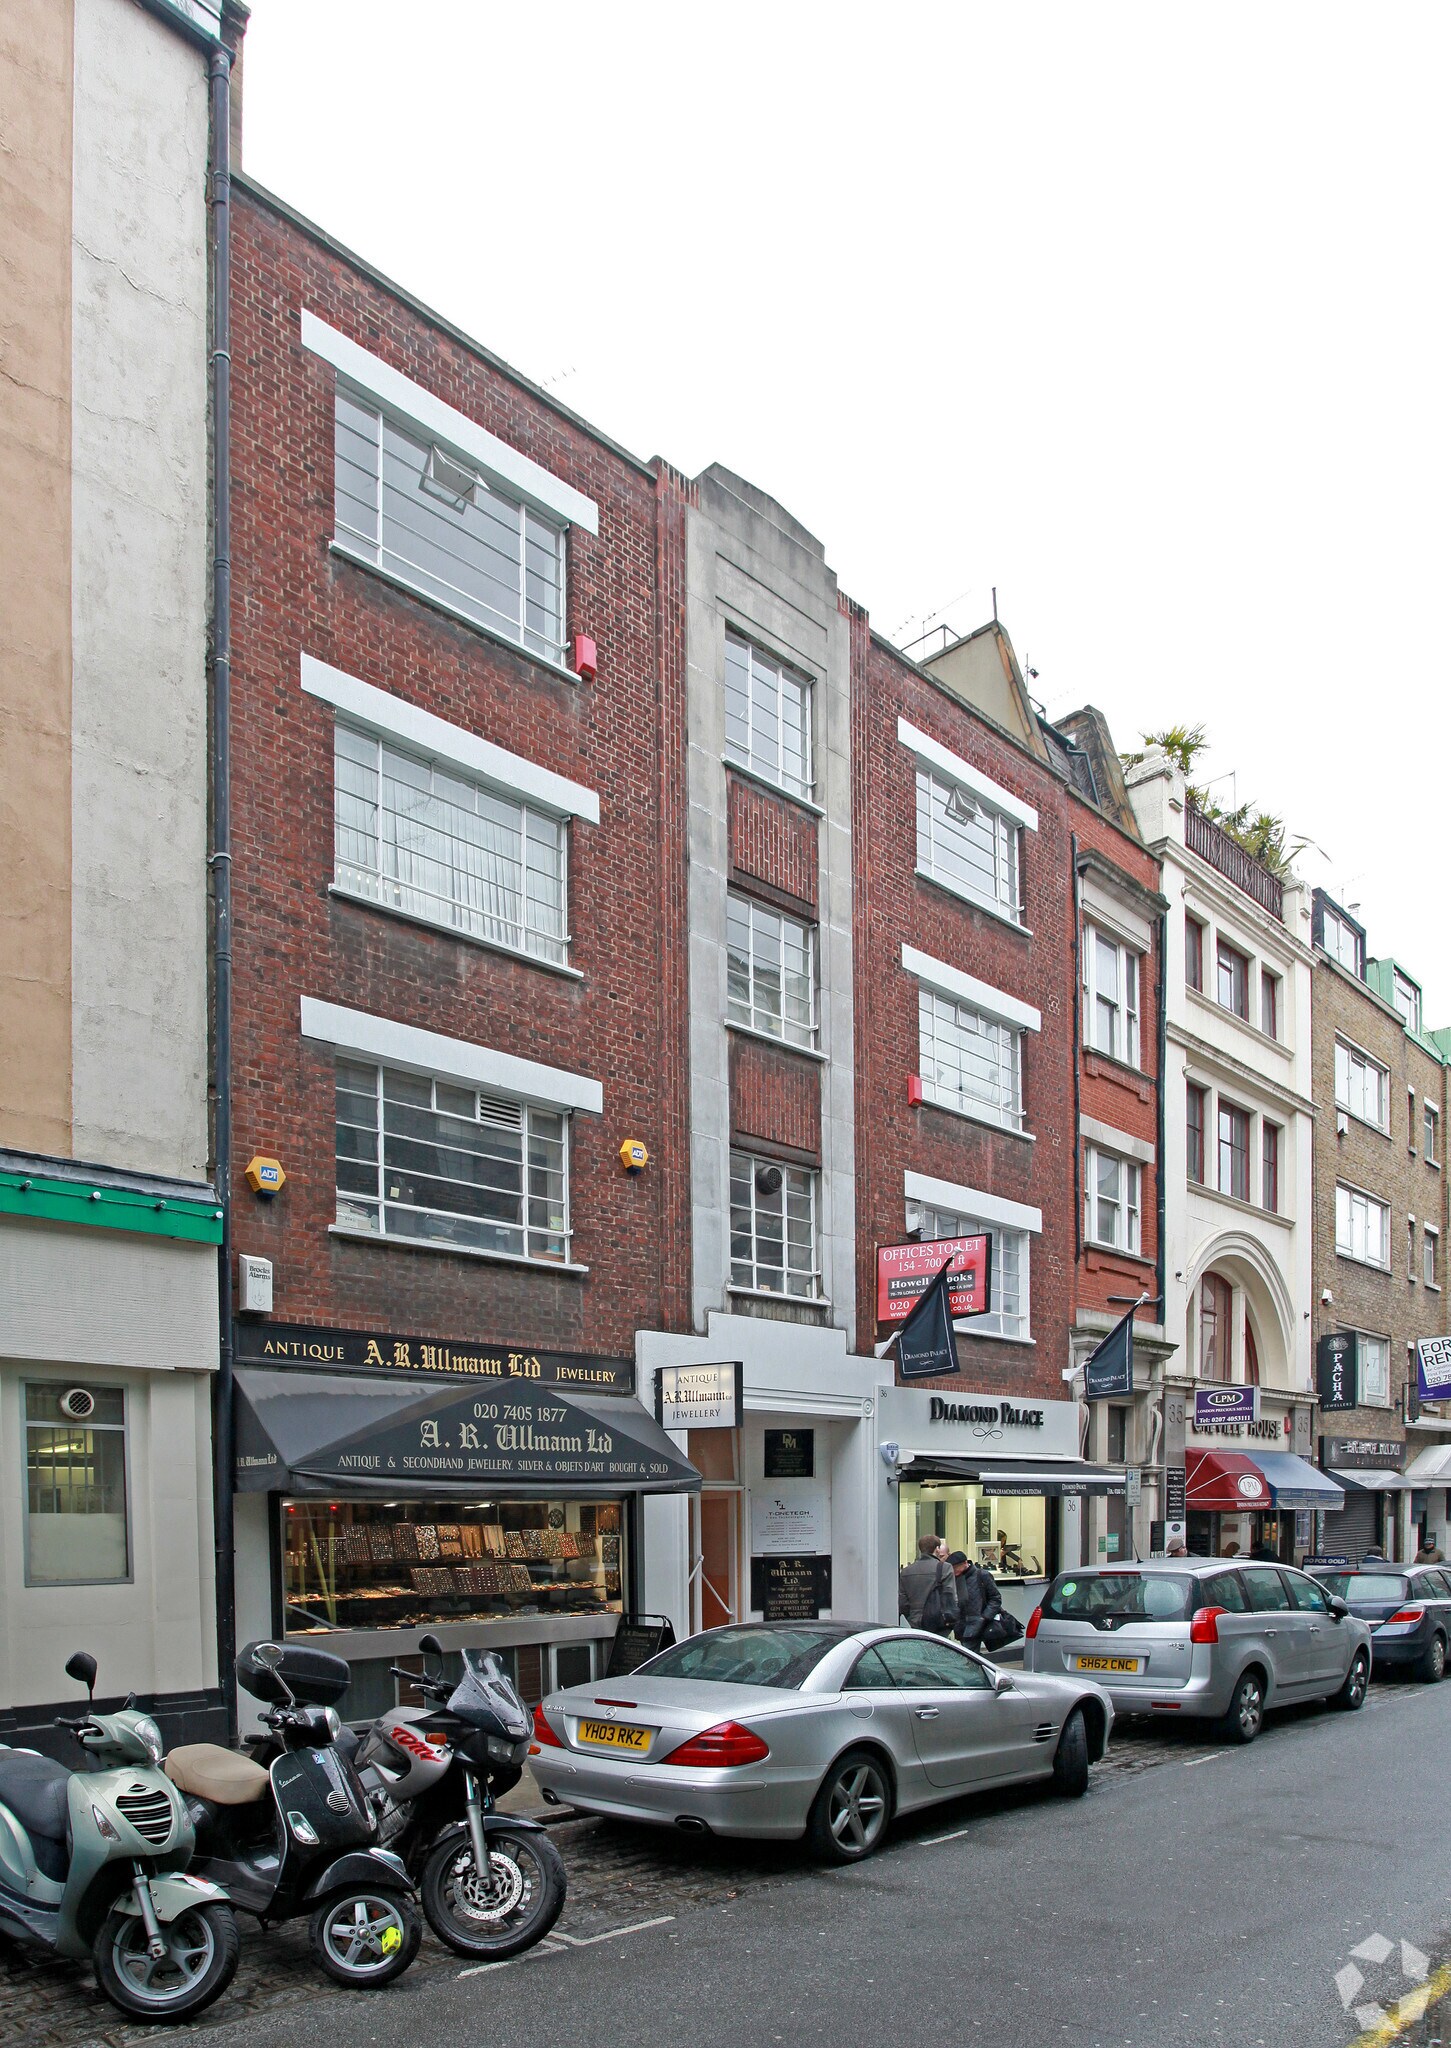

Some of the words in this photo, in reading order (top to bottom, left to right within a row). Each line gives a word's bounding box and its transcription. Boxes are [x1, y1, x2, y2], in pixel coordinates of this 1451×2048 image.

[261, 1169, 278, 1180] ADT
[883, 1245, 934, 1262] OFFICES
[937, 1242, 954, 1255] TO
[249, 1265, 271, 1274] Brocks
[899, 1260, 915, 1272] 154
[924, 1257, 942, 1269] 700
[957, 1254, 966, 1266] ft
[249, 1271, 271, 1280] Alarms
[891, 1277, 929, 1290] Howell
[889, 1300, 910, 1311] 020
[949, 1294, 974, 1305] 000
[264, 1340, 345, 1362] ANTIQUE
[1420, 1338, 1451, 1356] FOR
[508, 1353, 541, 1378] Ltd
[556, 1367, 616, 1383] JEWELLERY
[678, 1374, 718, 1384] ANTIQUE
[1332, 1353, 1344, 1402] PACHA
[1427, 1376, 1442, 1384] 020
[880, 1389, 888, 1398] 36
[1215, 1394, 1236, 1404] LPM
[473, 1403, 498, 1419] 020
[503, 1405, 533, 1421] 7405
[537, 1407, 567, 1423] 1877
[673, 1409, 720, 1420] JEWELLERY
[931, 1397, 999, 1423] DIAMOND
[1000, 1402, 1044, 1426] PALACE
[1168, 1403, 1184, 1424] 35
[420, 1420, 450, 1449] A.
[458, 1422, 489, 1450] R.
[493, 1424, 583, 1453] Ullmann
[585, 1428, 614, 1454] Ltd
[1248, 1419, 1281, 1438] HOUSE
[337, 1455, 381, 1470] ANTIQUE
[387, 1456, 396, 1468] &
[403, 1456, 464, 1470] SECONDHAND
[517, 1460, 544, 1472] SILVER
[546, 1461, 553, 1471] &
[554, 1460, 583, 1473] OBJETS
[609, 1462, 637, 1474] BOUGHT
[639, 1463, 646, 1473] &
[649, 1462, 669, 1474] SOLD
[1067, 1499, 1077, 1512] 36
[770, 1569, 813, 1577] Ullmann
[1080, 1658, 1108, 1669] SH62
[1110, 1660, 1133, 1670] CNC
[585, 1723, 616, 1741] YH03
[617, 1728, 645, 1746] RKZ
